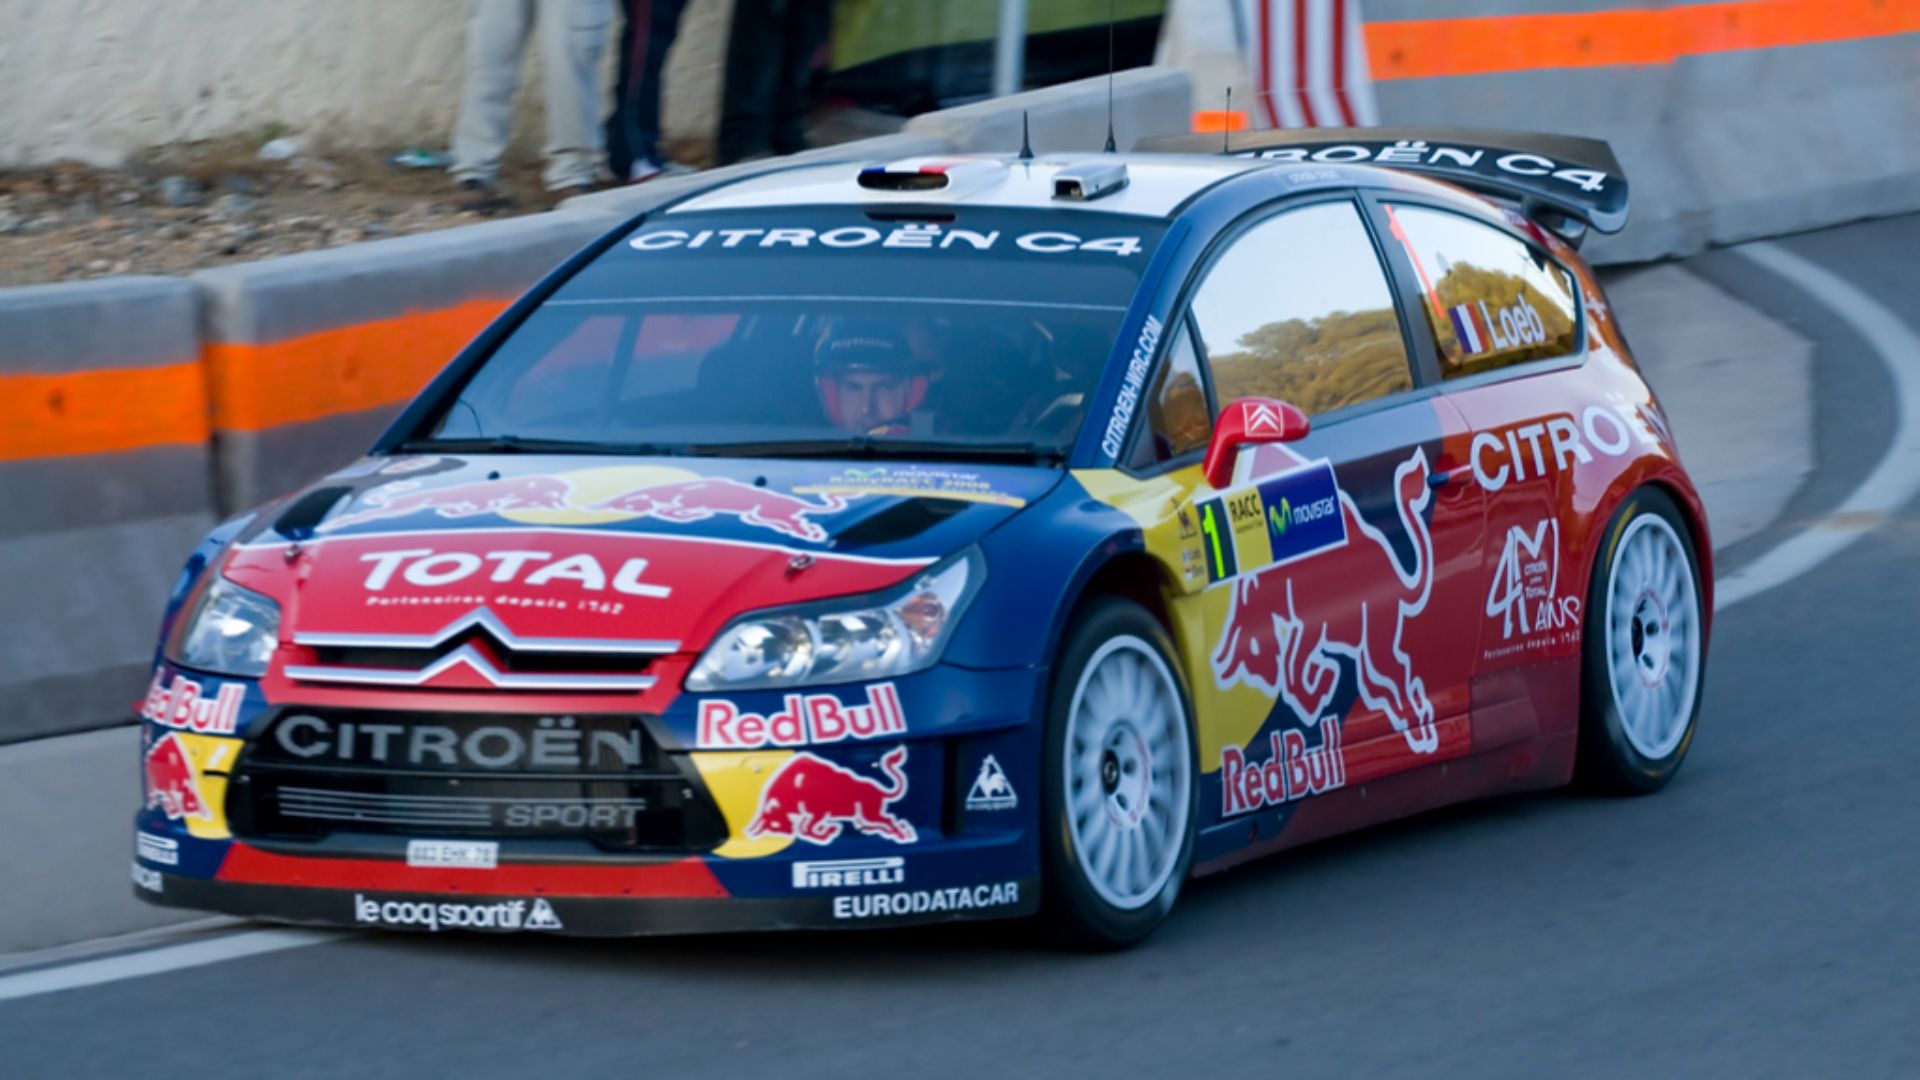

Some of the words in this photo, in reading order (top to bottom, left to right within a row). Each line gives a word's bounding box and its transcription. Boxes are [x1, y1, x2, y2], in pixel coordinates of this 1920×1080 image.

[1496, 155, 1608, 192] C4
[629, 223, 1000, 251] CITROËN
[1014, 232, 1144, 256] C4
[1480, 294, 1547, 350] Loeb
[1102, 314, 1163, 459] CITROEN-WRC.COM
[1229, 494, 1262, 523] RACC
[1293, 496, 1335, 525] movistar
[1202, 504, 1225, 579] 1
[359, 549, 672, 598] TOTAL
[697, 694, 808, 748] Red
[804, 682, 907, 744] Bull
[274, 715, 641, 767] CITROËN
[1220, 730, 1286, 818] Red
[1283, 716, 1345, 801] Bull
[504, 801, 647, 828] SPORT
[792, 856, 904, 888] PIRELLI
[833, 881, 1018, 918] EURODATACAR
